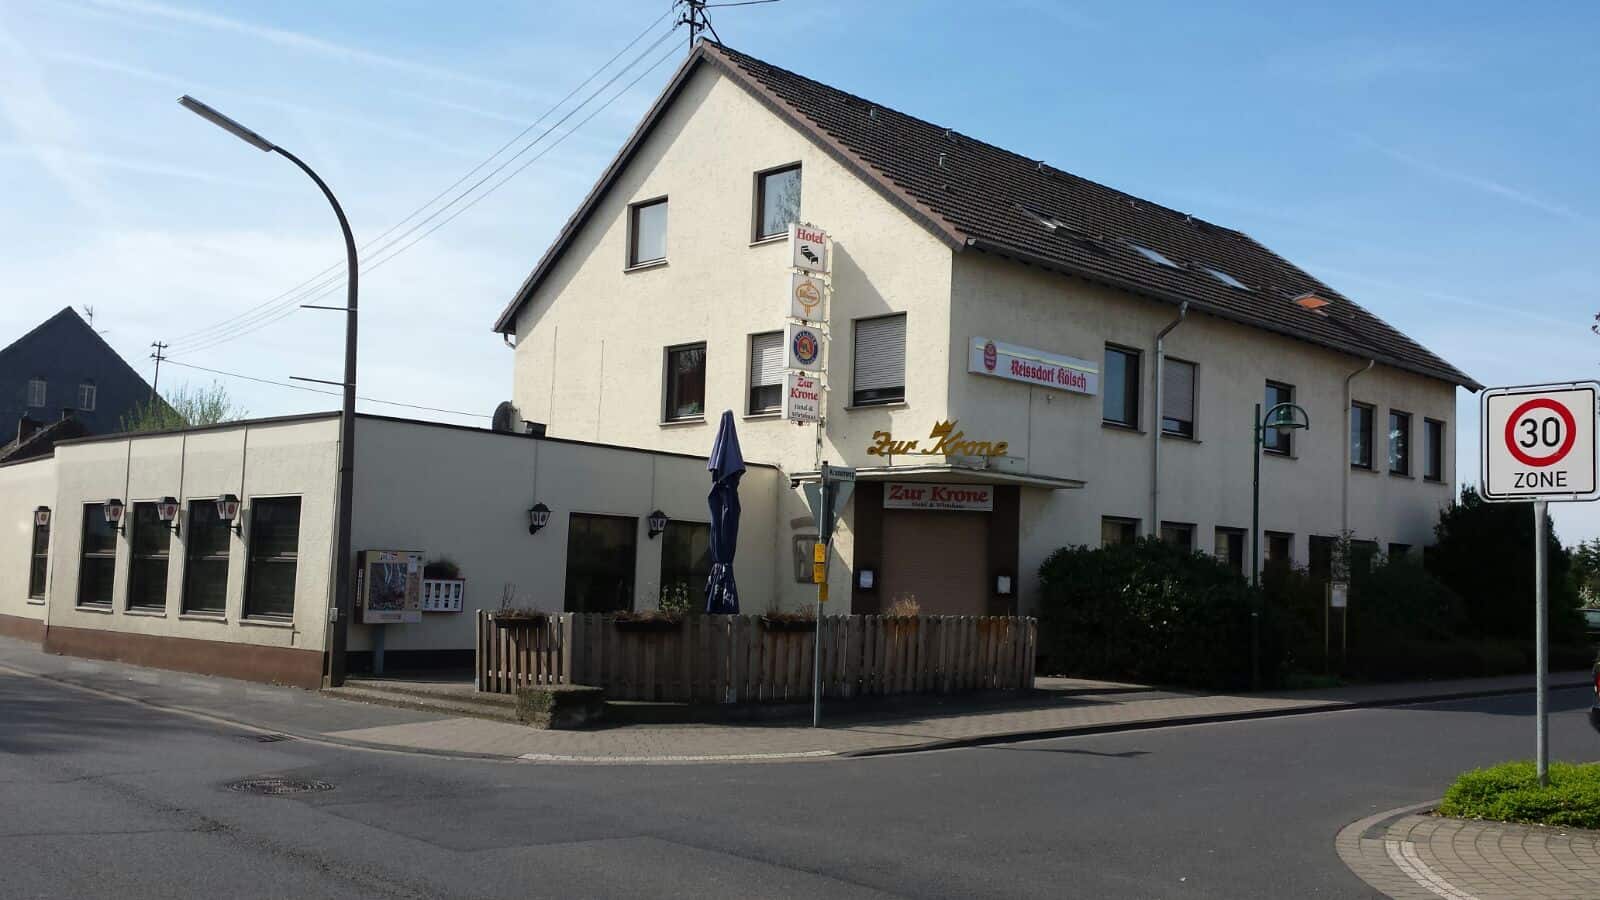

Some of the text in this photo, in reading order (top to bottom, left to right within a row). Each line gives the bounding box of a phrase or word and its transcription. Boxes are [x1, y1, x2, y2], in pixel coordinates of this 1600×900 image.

[797, 228, 824, 244] Hotel
[797, 378, 813, 388] Zur
[1011, 359, 1086, 392] Reissdorf Kölsch
[790, 387, 818, 401] Krone
[1520, 416, 1561, 449] 30
[867, 428, 1009, 457] Zur Krone
[1514, 471, 1568, 488] ZONE
[889, 484, 989, 503] Zur Krone
